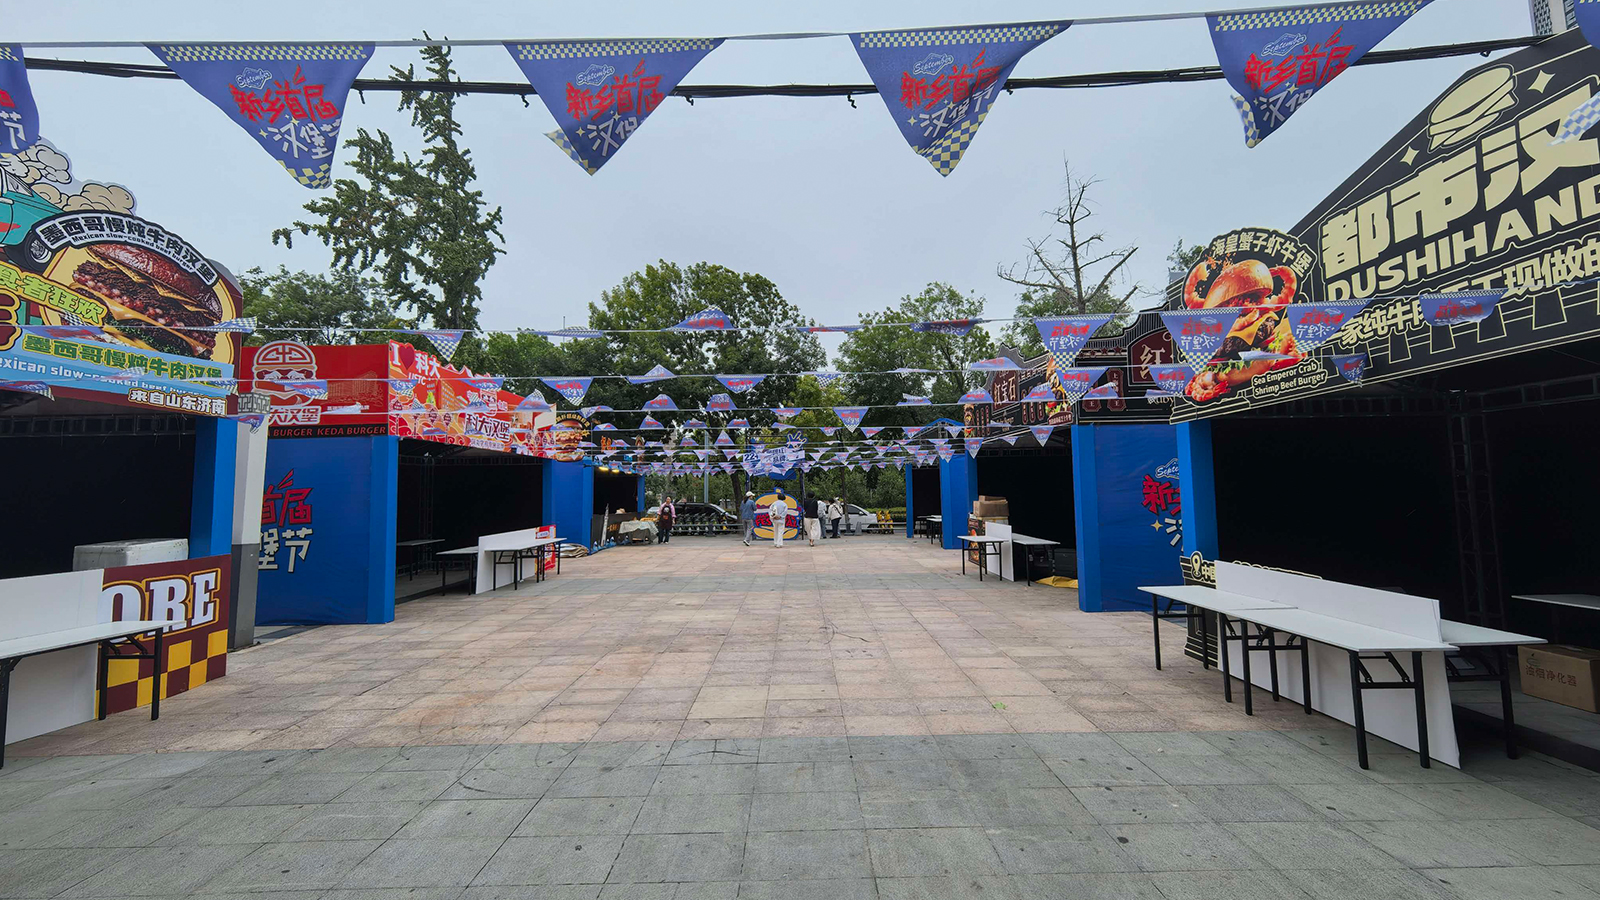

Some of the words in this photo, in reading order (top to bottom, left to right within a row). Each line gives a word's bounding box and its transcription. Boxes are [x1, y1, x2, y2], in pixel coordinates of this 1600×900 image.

[576, 65, 615, 86] September
[1244, 27, 1355, 94] 新乡首届
[229, 64, 339, 123] 新乡首届
[566, 58, 664, 121] 新乡首届
[40, 216, 218, 283] 墨西哥慢炖牛肉汉堡
[72, 233, 104, 243] Mexican
[106, 233, 154, 247] slow-cooked
[156, 243, 171, 253] beef
[173, 253, 193, 271] burger
[1212, 231, 1312, 278] 海皇蟹子虾牛堡
[0, 358, 45, 374] xican
[1254, 377, 1265, 386] Sea
[1267, 368, 1297, 382] Emperor
[1299, 362, 1317, 374] Crab
[1255, 384, 1279, 396] Shrimp
[1280, 378, 1297, 390] Beef
[1298, 373, 1325, 384] Burger
[131, 390, 226, 416] 来自山东济南
[273, 428, 312, 437] BURGER
[317, 427, 344, 436] KEDA
[347, 426, 386, 435] BURGER
